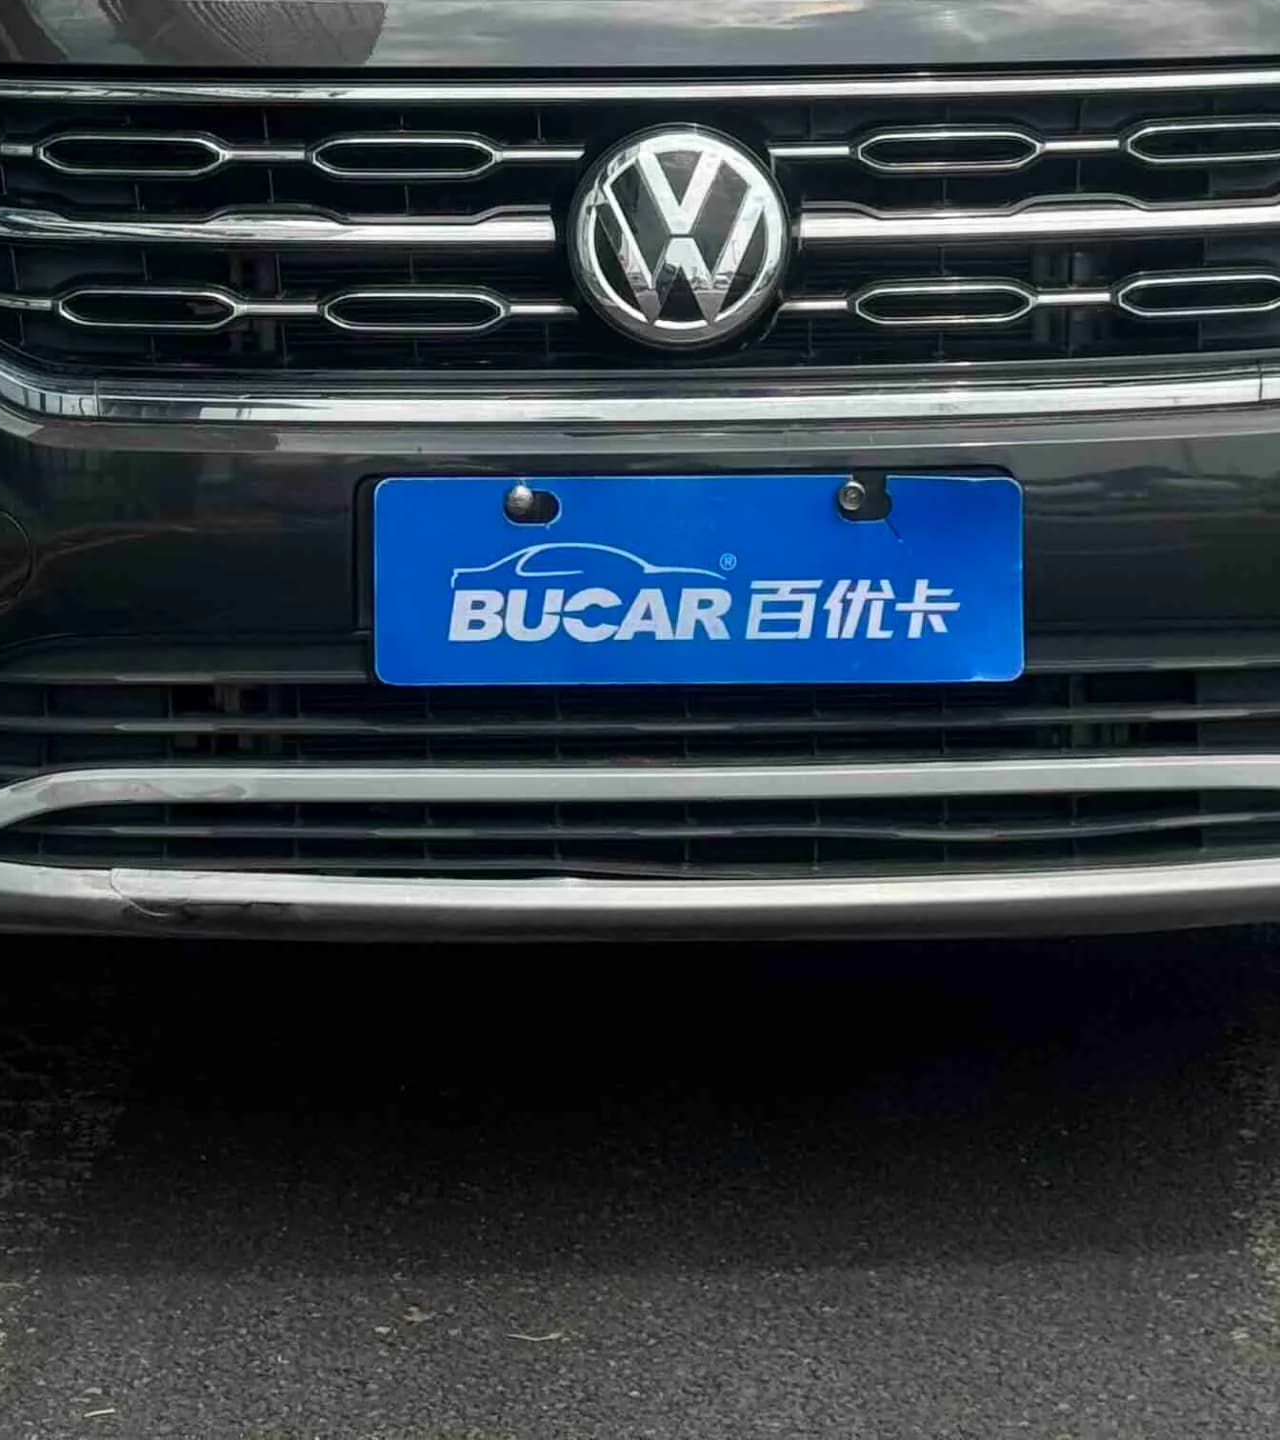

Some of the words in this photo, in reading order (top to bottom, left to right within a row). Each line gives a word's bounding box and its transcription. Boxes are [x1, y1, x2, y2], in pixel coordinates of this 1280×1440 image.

[448, 588, 732, 642] BUCAR
[745, 579, 961, 640] 百优卡
